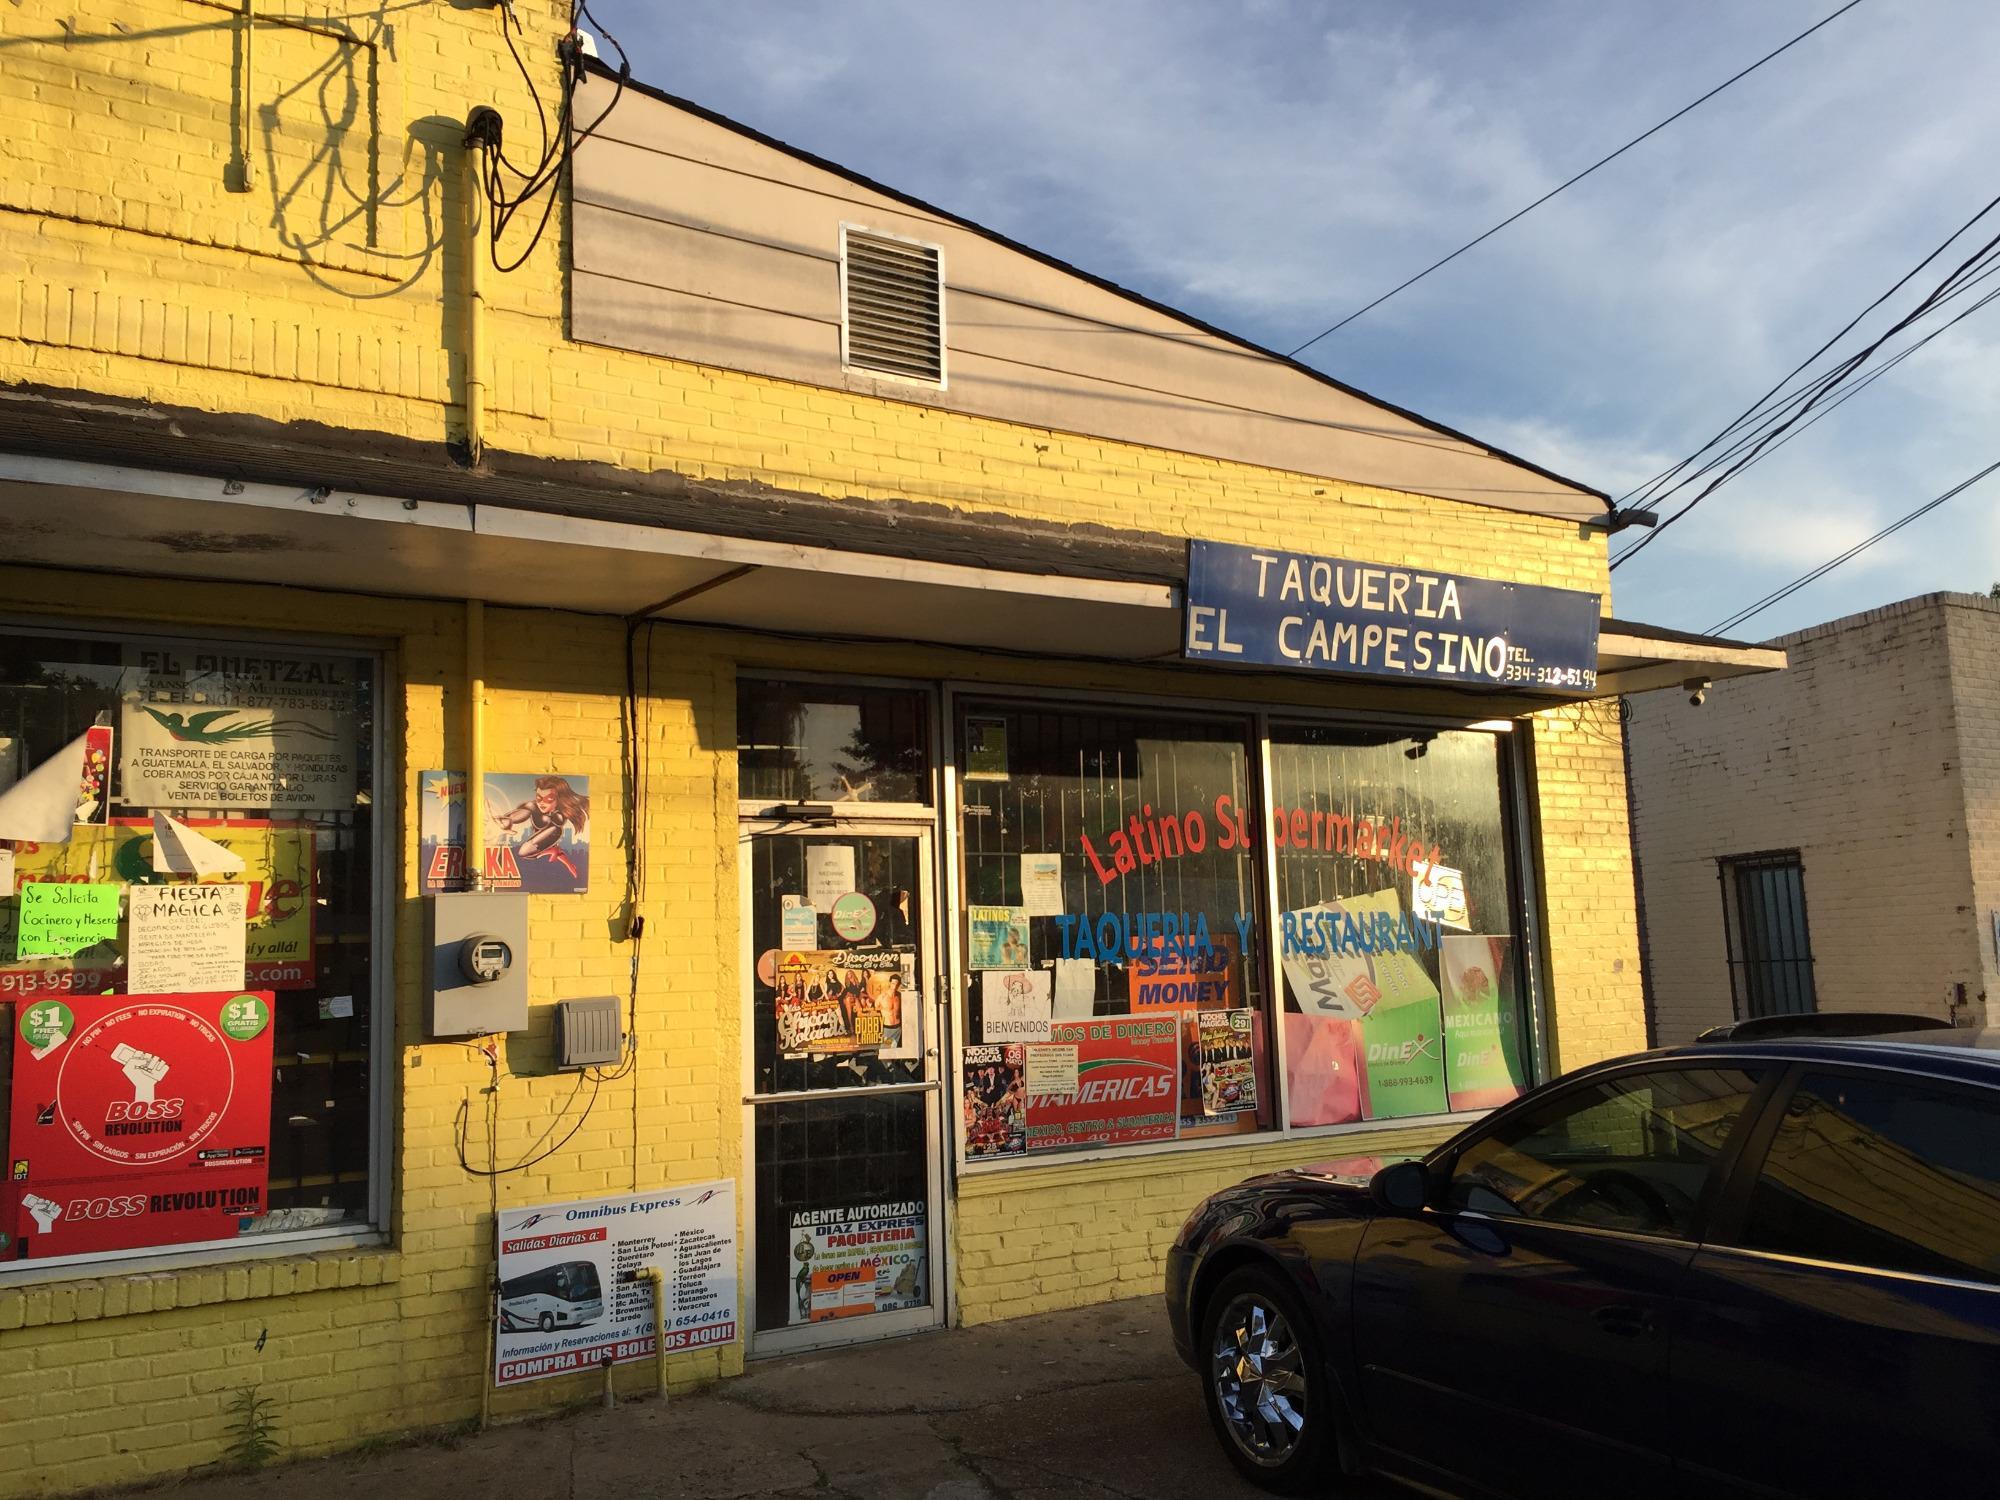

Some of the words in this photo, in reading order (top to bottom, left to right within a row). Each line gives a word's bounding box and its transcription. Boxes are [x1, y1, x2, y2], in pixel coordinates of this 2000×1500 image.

[1252, 554, 1462, 620] TAQUERIA
[1189, 606, 1242, 653] EL
[1277, 615, 1506, 678] CAMPESINO
[1507, 646, 1534, 664] TEL.
[141, 651, 180, 675] EL
[139, 748, 211, 759] TRANSPORTE
[213, 750, 227, 759] DE
[230, 751, 266, 760] CARGA
[268, 752, 289, 761] POR
[131, 759, 139, 767] A
[212, 761, 226, 769] EL
[143, 770, 206, 779] COBRAMOS
[208, 771, 230, 780] POR
[232, 772, 259, 781] CAJA
[262, 772, 277, 781] NO
[179, 781, 227, 790] SERVICIO
[168, 792, 201, 800] VENTA
[203, 792, 218, 801] DE
[220, 792, 268, 801] BOLETOS
[270, 793, 283, 801] DE
[286, 793, 315, 802] AVION
[1080, 803, 1207, 886] Latino
[1215, 794, 1441, 887] Supermarket
[428, 846, 521, 879] ERKA
[26, 886, 42, 904] Se
[53, 886, 99, 904] Solicita
[23, 910, 72, 926] Cocinero
[973, 909, 1010, 922] LATINOS
[1056, 911, 1211, 964] TAQUERIA
[1234, 912, 1251, 957] Y
[1281, 911, 1444, 955] RESTAURANT
[1138, 945, 1229, 976] SEND
[1138, 981, 1229, 1005] MONEY
[30, 1007, 64, 1028] $1
[229, 1001, 259, 1020] $1
[985, 1020, 1049, 1034] BIENVENIDOS
[1091, 1027, 1111, 1039] DE
[1117, 1021, 1176, 1038] DINERO
[967, 1047, 1000, 1057] NOCHES
[1008, 1051, 1022, 1060] 06
[965, 1055, 1002, 1065] MAGICAS
[1005, 1059, 1023, 1068] MAYO
[1378, 1075, 1433, 1088] 1-888-993-4639
[106, 1098, 184, 1122] BOSS
[105, 1119, 182, 1137] REVOLUTION
[1087, 1127, 1174, 1141] 401-7626
[65, 1195, 147, 1222] BOSS
[151, 1186, 259, 1213] REVOLUTION
[566, 1205, 626, 1221] Omnibus
[630, 1198, 681, 1214] Express
[793, 1208, 844, 1227] AGENTE
[847, 1201, 925, 1220] AUTORIZADO
[816, 1223, 852, 1237] DIAZ
[858, 1216, 924, 1232] EXPRESS
[506, 1238, 546, 1253] Salidas
[549, 1232, 586, 1247] Diarias
[617, 1236, 656, 1248] Monterrey
[679, 1233, 716, 1245] Zacatecas
[828, 1227, 915, 1248] PAQUETERIA
[617, 1247, 632, 1256] San
[634, 1244, 650, 1253] Luis
[679, 1238, 732, 1254] Aguascalientes
[679, 1251, 693, 1260] San
[694, 1248, 711, 1258] Juan
[712, 1247, 722, 1255] de
[617, 1260, 642, 1271] Celaya
[679, 1259, 689, 1267] los
[691, 1256, 713, 1267] Lagos
[678, 1262, 721, 1276] Guadalajara
[828, 1271, 860, 1284] OPEN
[616, 1285, 629, 1294] San
[678, 1280, 702, 1290] Toluca
[678, 1286, 708, 1298] Durango
[616, 1300, 626, 1308] Mc
[678, 1292, 718, 1305] Matamoros
[678, 1301, 710, 1312] Veracruz
[615, 1313, 642, 1323] Laredo
[561, 1331, 620, 1349] Reservaciones
[676, 1308, 730, 1327] 654-0416
[502, 1354, 576, 1379] COMPRA
[581, 1348, 613, 1365] TUS
[617, 1332, 689, 1358] BOLEOS
[690, 1325, 733, 1345] AQUI!
